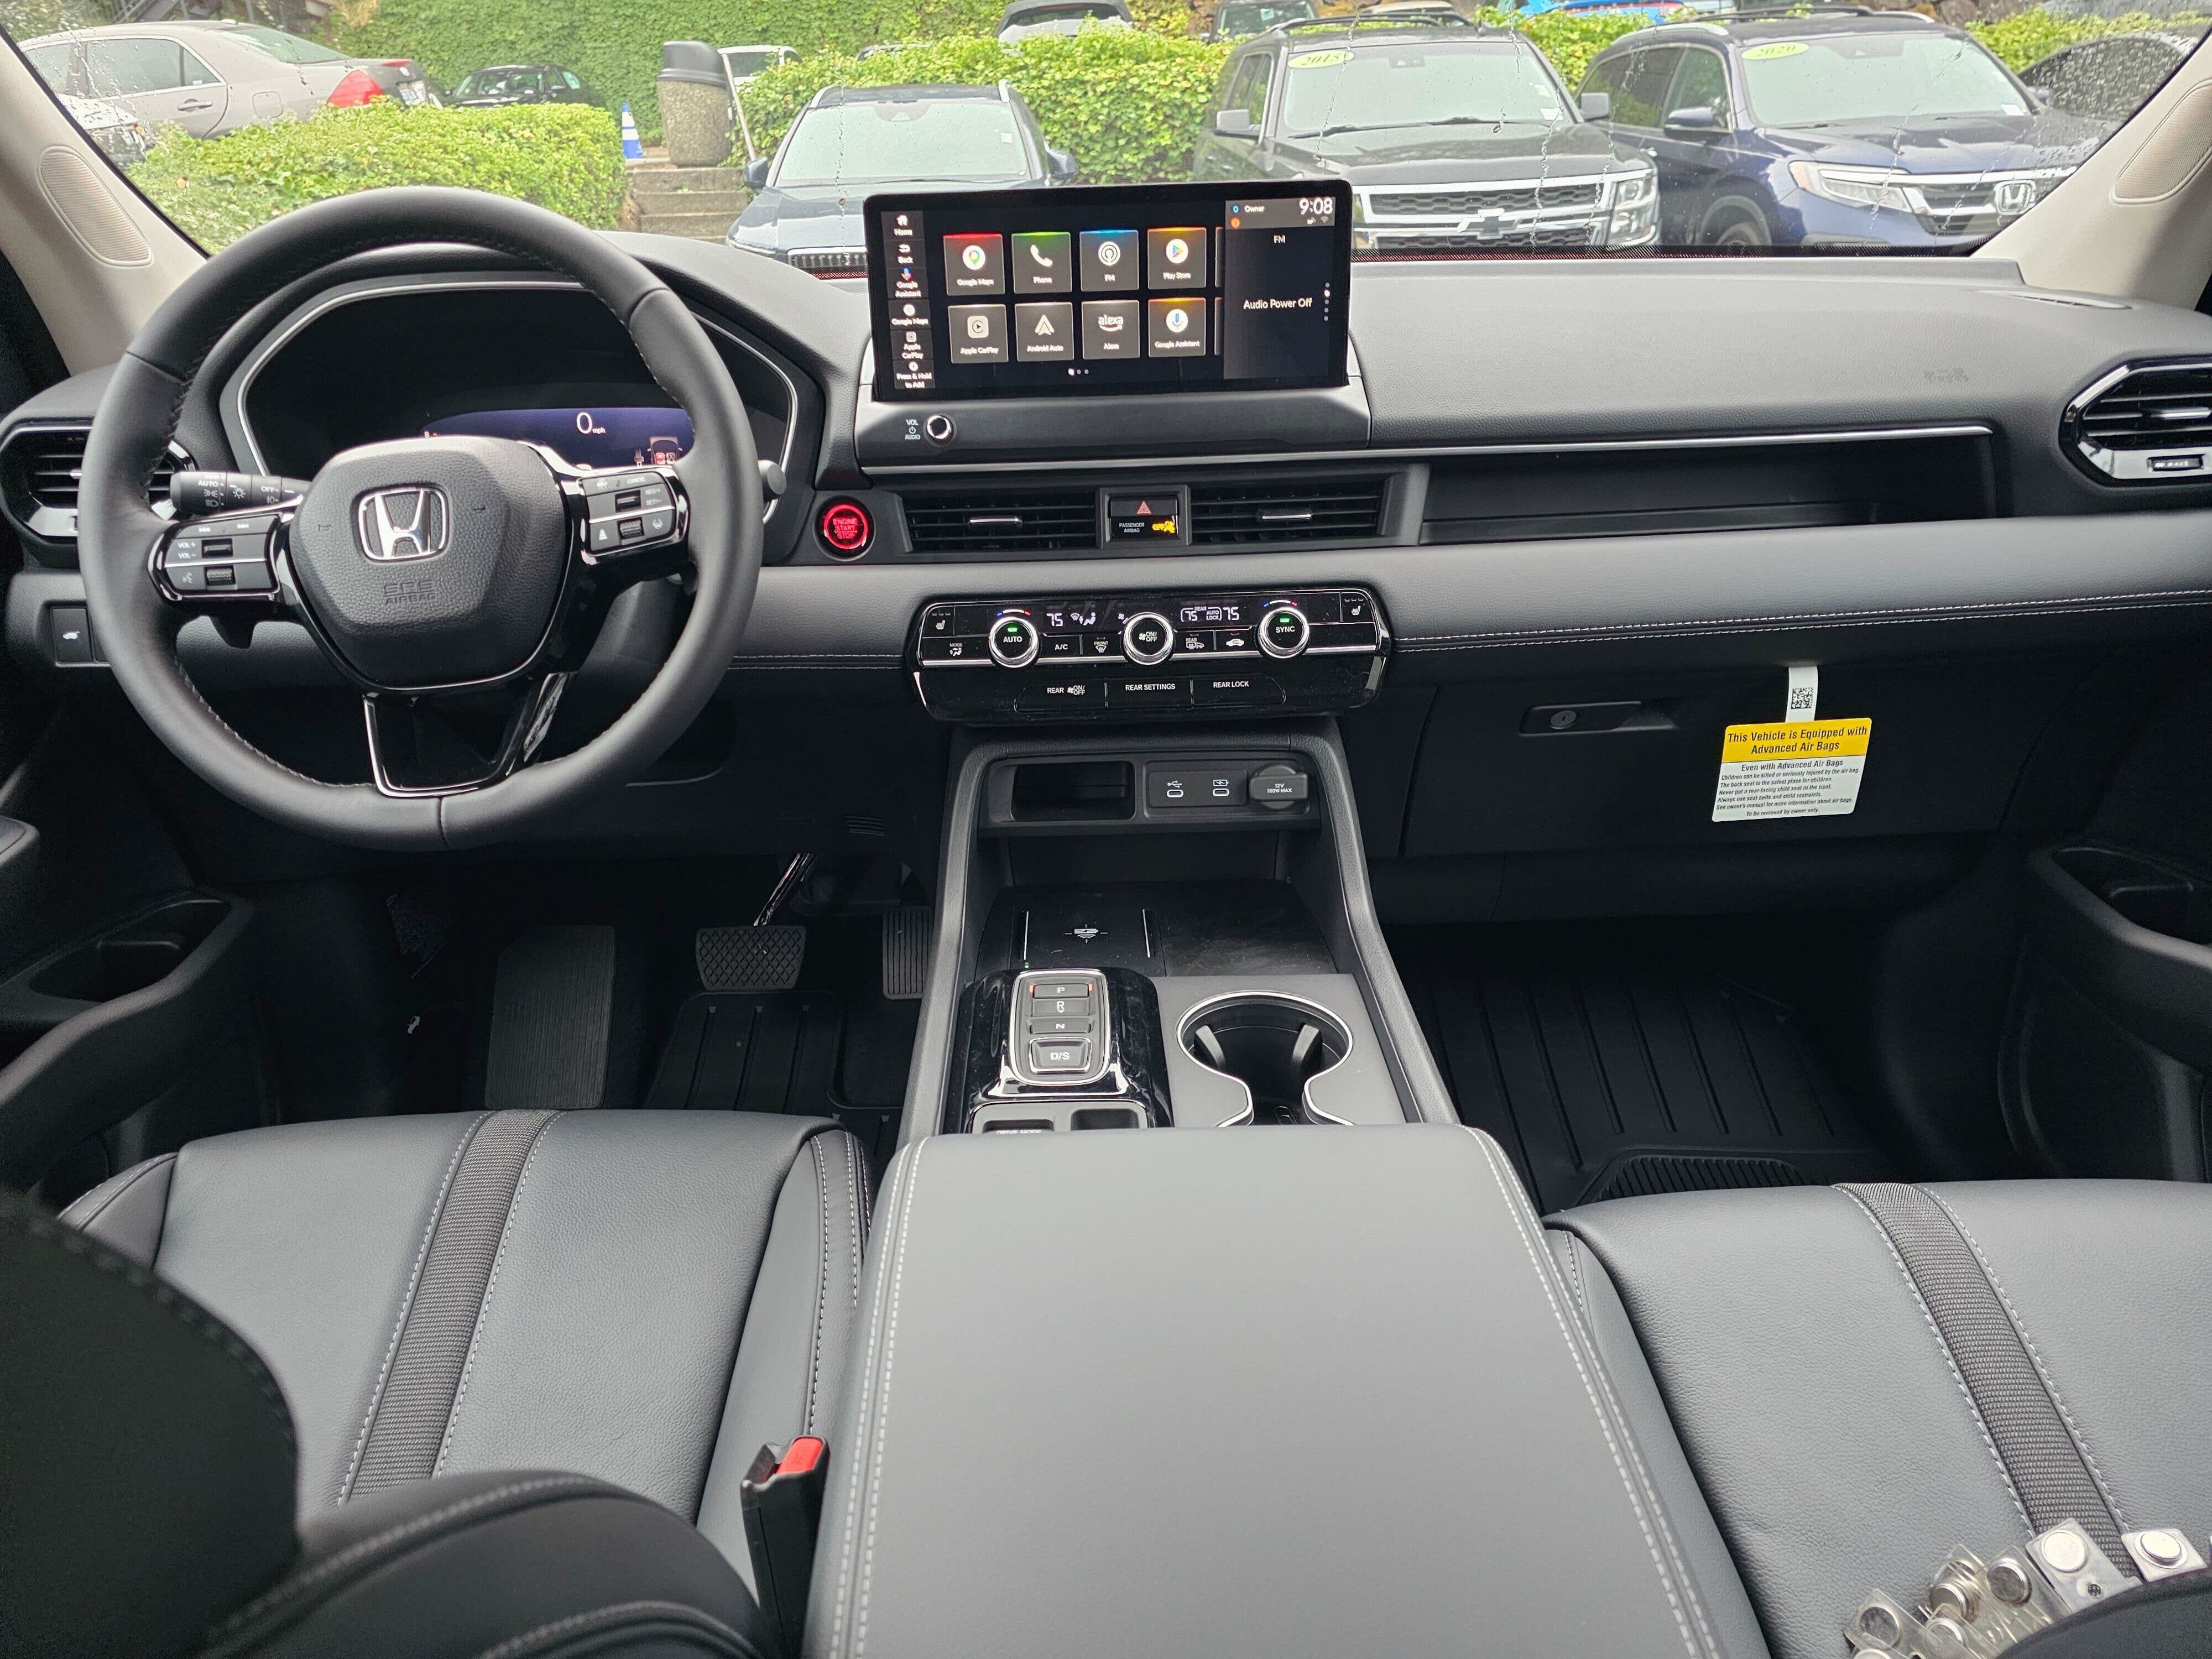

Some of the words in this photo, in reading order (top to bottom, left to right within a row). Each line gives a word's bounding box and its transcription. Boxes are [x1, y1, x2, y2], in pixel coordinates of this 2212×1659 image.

[1756, 45, 1796, 57] 2020
[1301, 53, 1342, 65] 2015
[1300, 197, 1333, 215] 9:08
[1274, 235, 1285, 243] FM
[1244, 299, 1268, 309] Audio
[1270, 299, 1296, 309] Power
[1298, 298, 1312, 307] Off
[1098, 314, 1124, 325] alexa
[960, 347, 977, 355] Apple
[577, 412, 592, 434] 0
[385, 592, 436, 606] AIRBAG
[1185, 611, 1198, 622] 75
[1223, 607, 1239, 620] 75
[1046, 613, 1063, 627] 75
[1728, 733, 1747, 743] This
[1751, 731, 1786, 742] Vehicle
[1789, 730, 1798, 739] is
[1800, 727, 1845, 740] Equipped
[1848, 726, 1867, 735] with
[1751, 743, 1797, 754] Advanced
[1799, 742, 1814, 752] Air
[1817, 741, 1840, 752] Bags
[1777, 760, 1812, 770] Advanced
[1826, 759, 1844, 768] Bags
[1057, 1001, 1065, 1011] R
[1050, 1052, 1070, 1060] D/S
